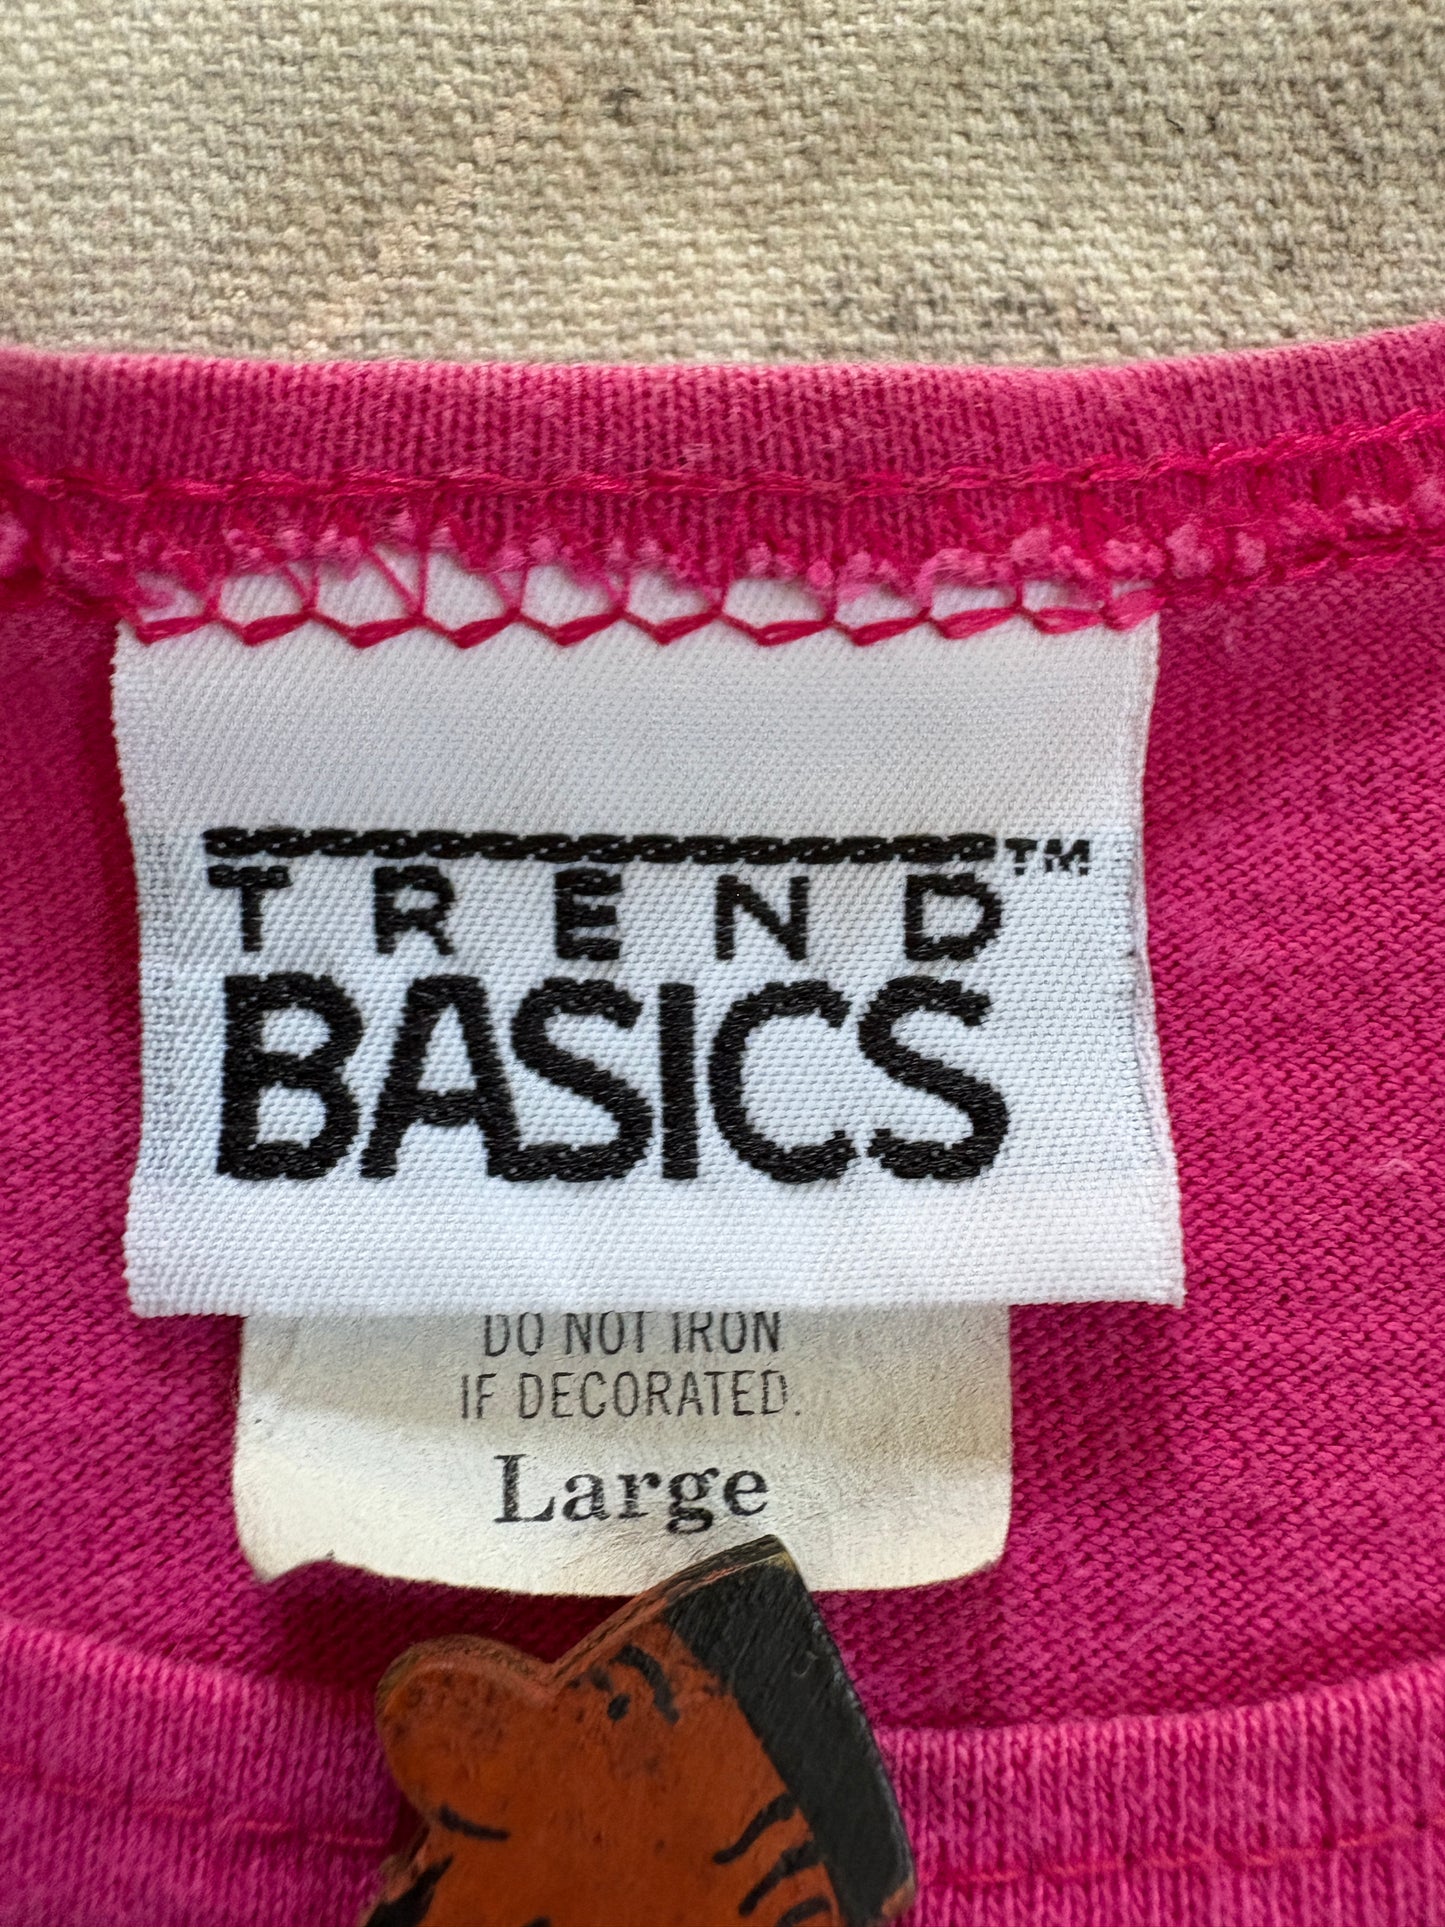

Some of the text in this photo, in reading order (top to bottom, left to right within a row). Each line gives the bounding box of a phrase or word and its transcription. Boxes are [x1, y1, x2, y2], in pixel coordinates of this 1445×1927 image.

[206, 863, 1001, 961] TREND
[216, 971, 1010, 1182] BASICS
[483, 1310, 782, 1357] DO NOT IRON
[460, 1369, 801, 1419] IF DECORATED.
[493, 1453, 769, 1535] Large
